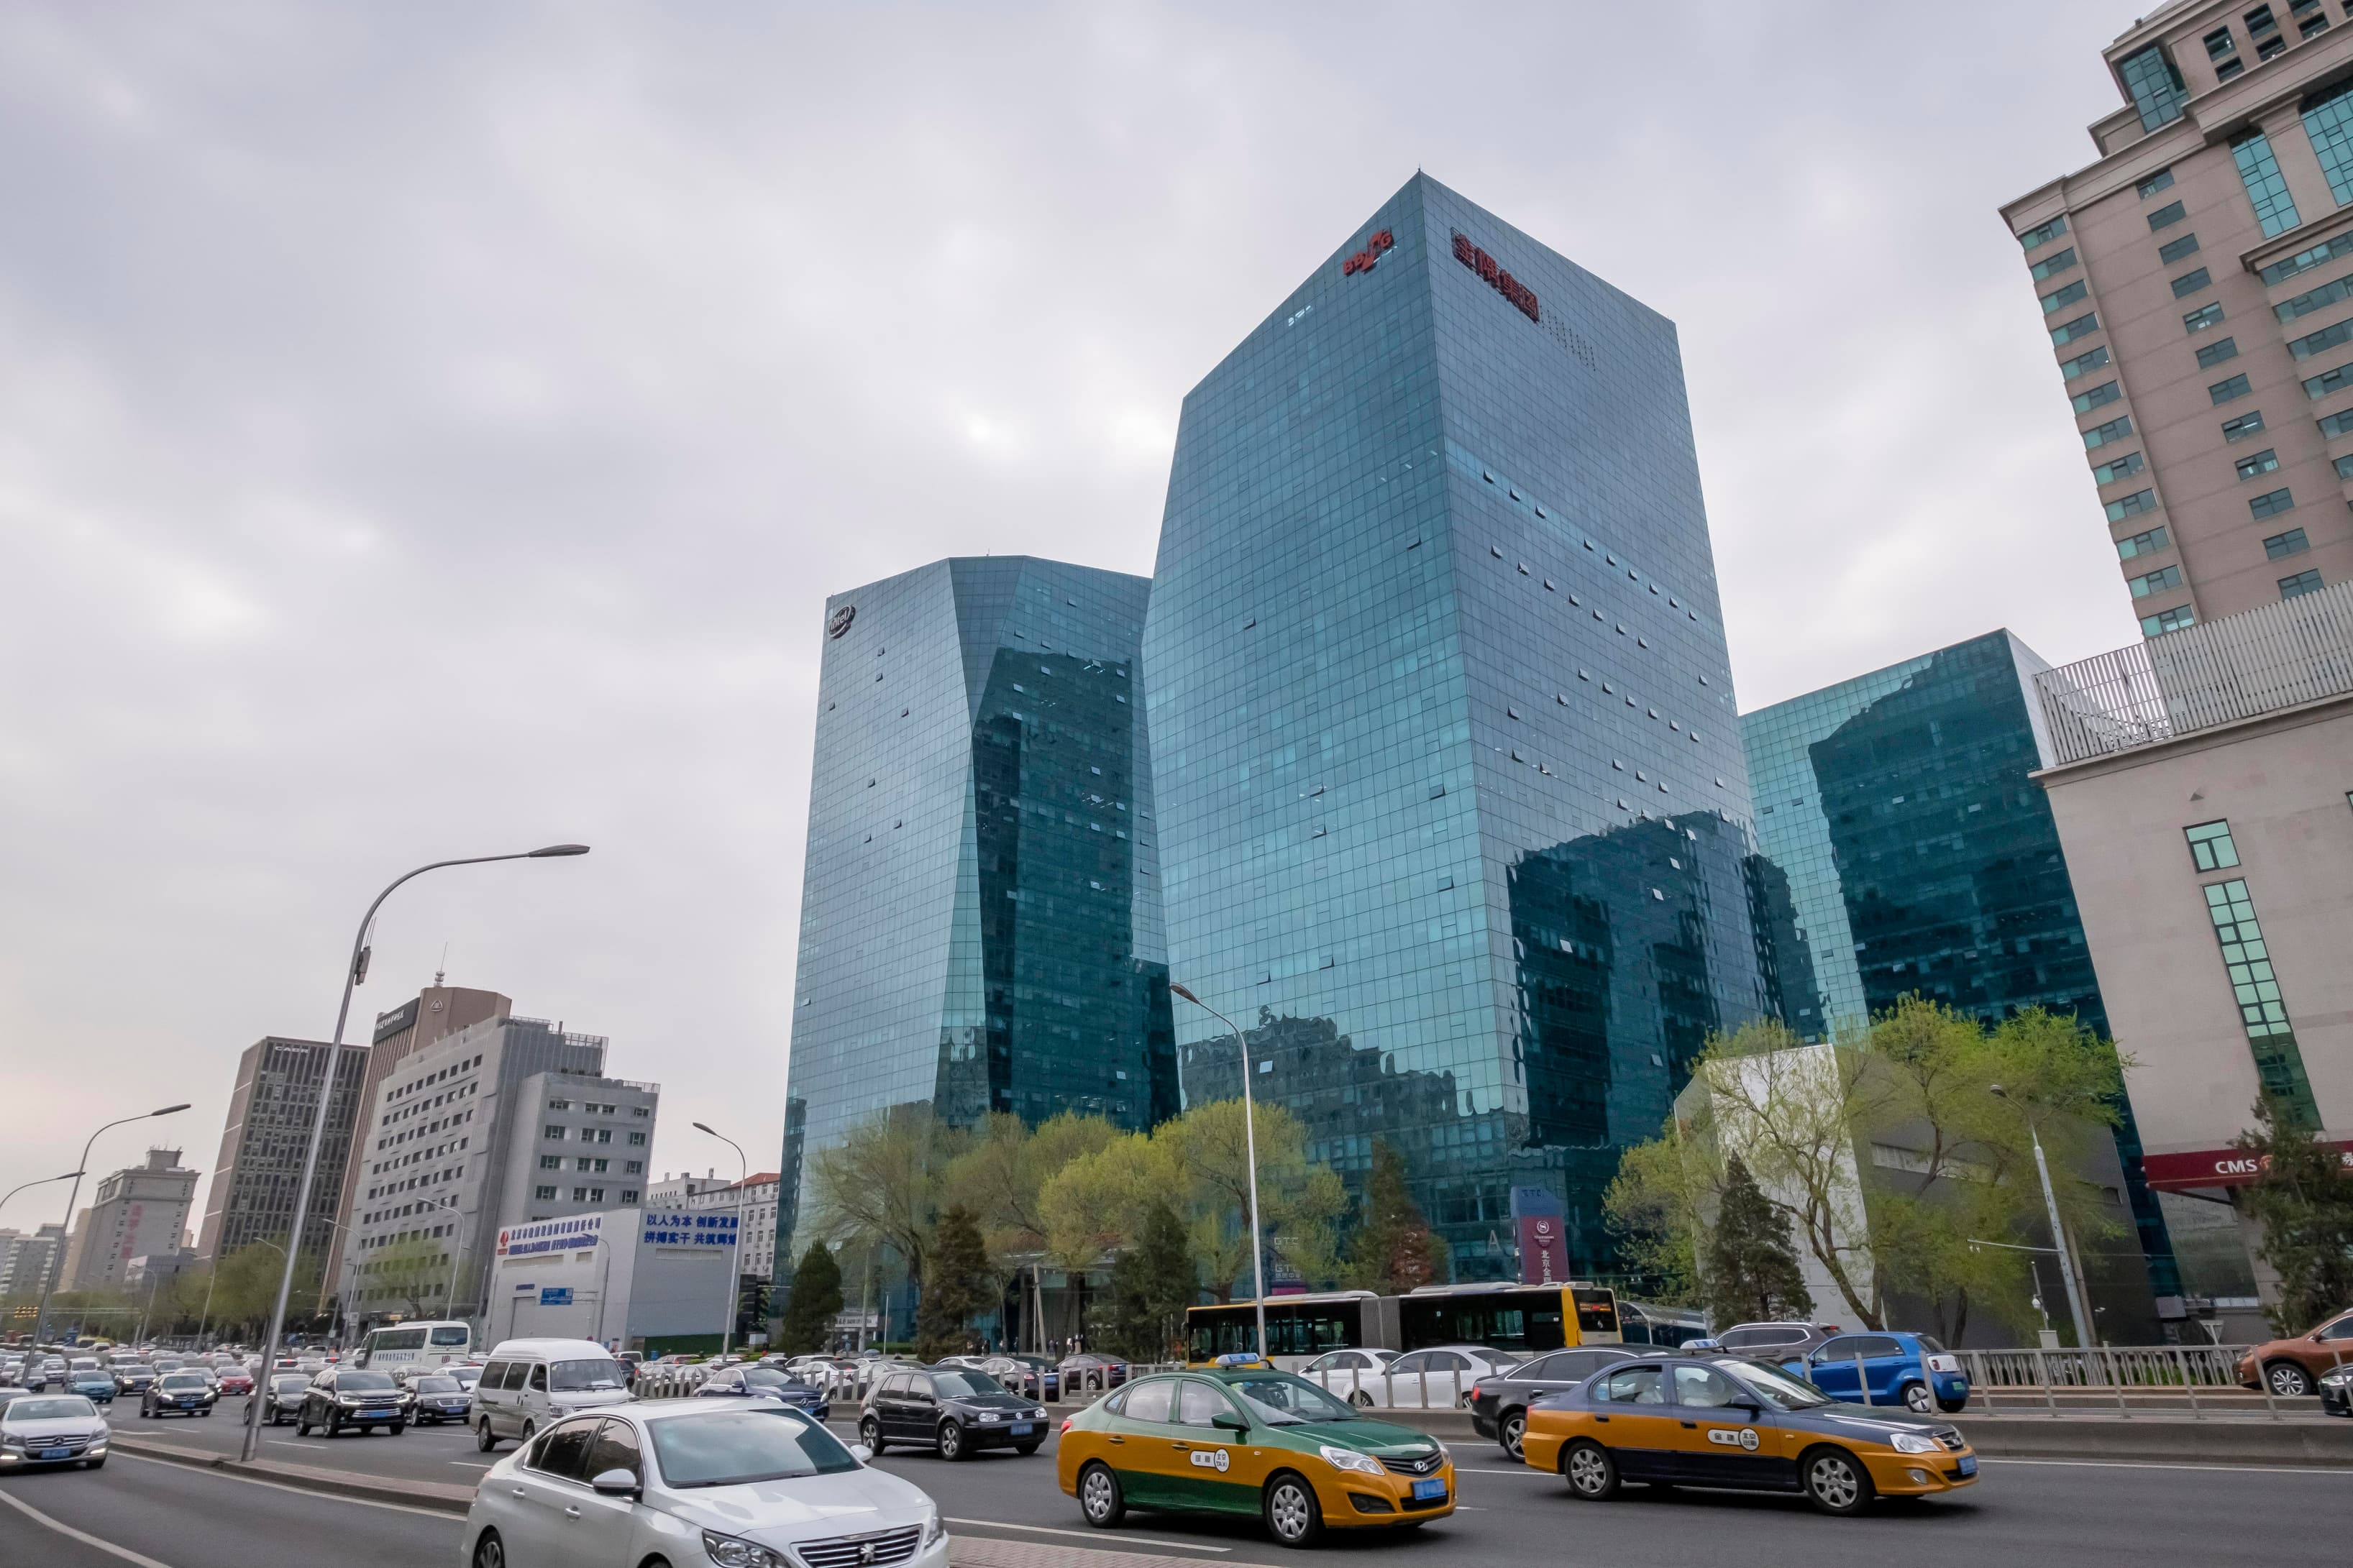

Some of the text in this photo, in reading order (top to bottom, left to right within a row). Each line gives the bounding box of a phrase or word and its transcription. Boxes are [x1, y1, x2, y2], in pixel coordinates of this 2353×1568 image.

[1454, 234, 1539, 320] 金隅集团
[2215, 1159, 2258, 1174] CMS
[646, 1214, 692, 1227] 以人为本
[644, 1231, 690, 1244] 拼搏实干
